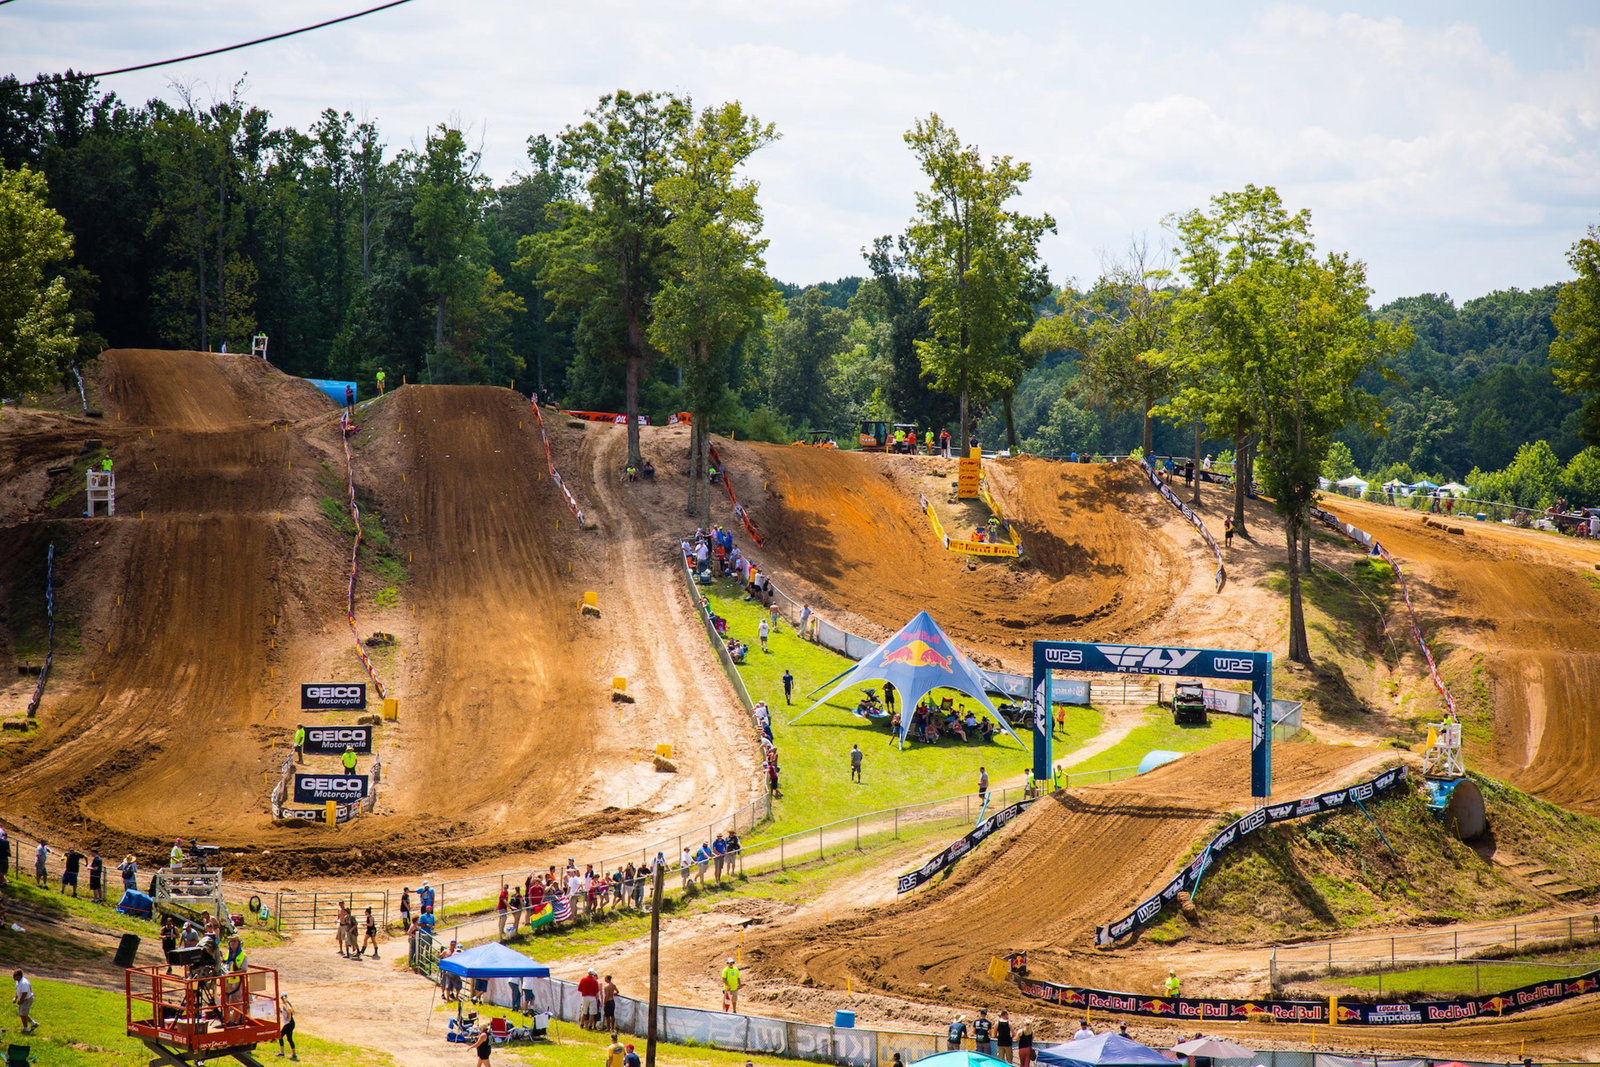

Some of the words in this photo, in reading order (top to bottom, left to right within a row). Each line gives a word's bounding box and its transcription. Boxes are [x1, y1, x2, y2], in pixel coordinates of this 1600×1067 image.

[1045, 648, 1083, 664] WPS
[1094, 646, 1201, 669] FLY
[1117, 666, 1179, 675] RACING
[1213, 657, 1254, 674] WPS
[307, 687, 361, 698] GEICO
[309, 730, 366, 741] GEICO
[301, 778, 362, 791] GEICO
[1349, 782, 1373, 802] WPS
[314, 790, 362, 800] Motorcycle
[996, 805, 1017, 828] WPS
[1240, 809, 1266, 834] WPS
[1137, 896, 1161, 923] WPS
[1368, 1013, 1421, 1022] MOTOCROSS
